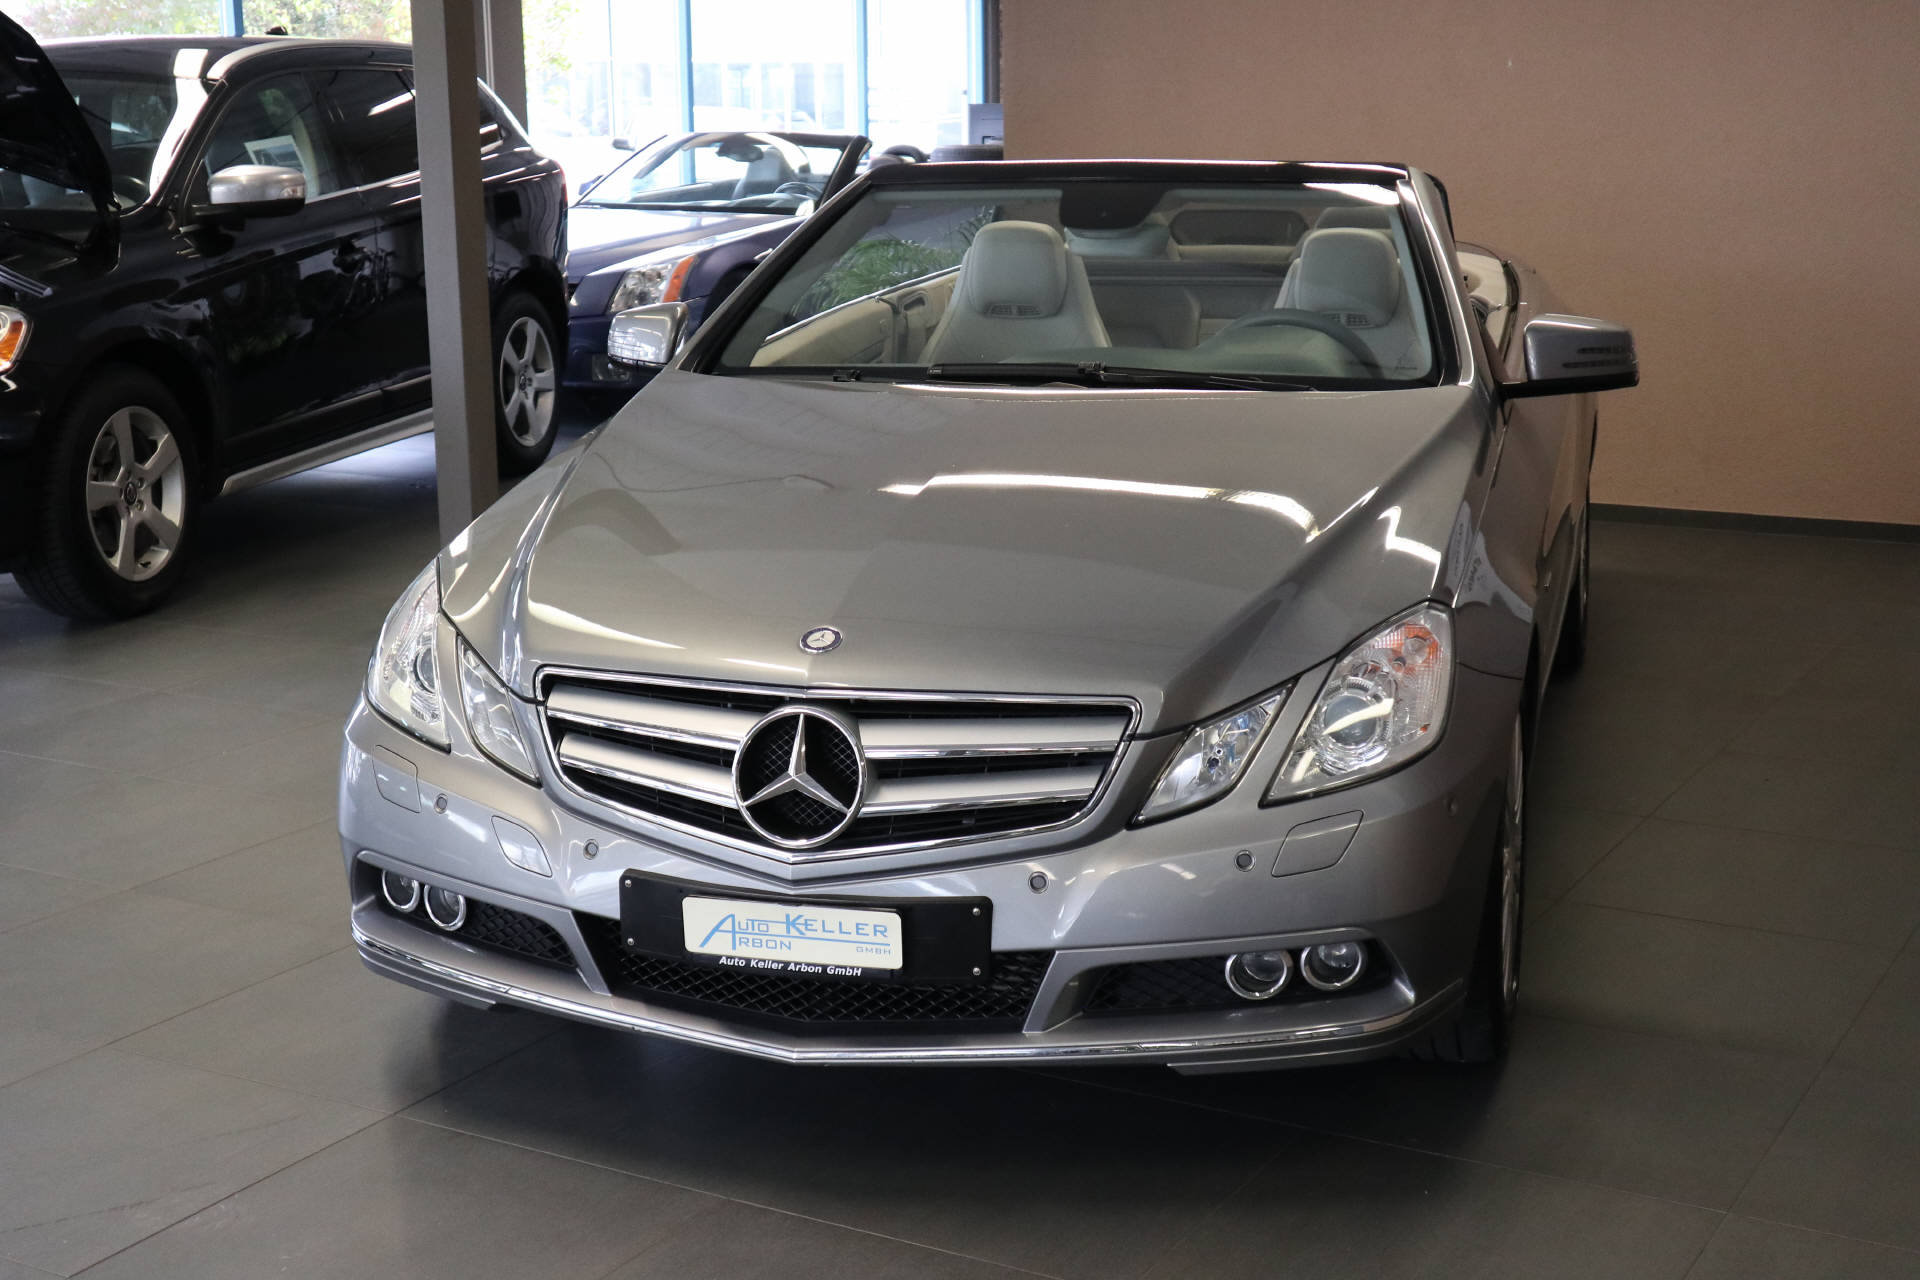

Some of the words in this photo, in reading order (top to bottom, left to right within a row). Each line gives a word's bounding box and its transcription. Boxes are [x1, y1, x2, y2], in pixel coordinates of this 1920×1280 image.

[784, 913, 888, 938] KELLER
[719, 956, 745, 967] Auto
[750, 959, 784, 970] Keller
[787, 962, 822, 975] Arbon
[827, 966, 862, 977] GmbH
